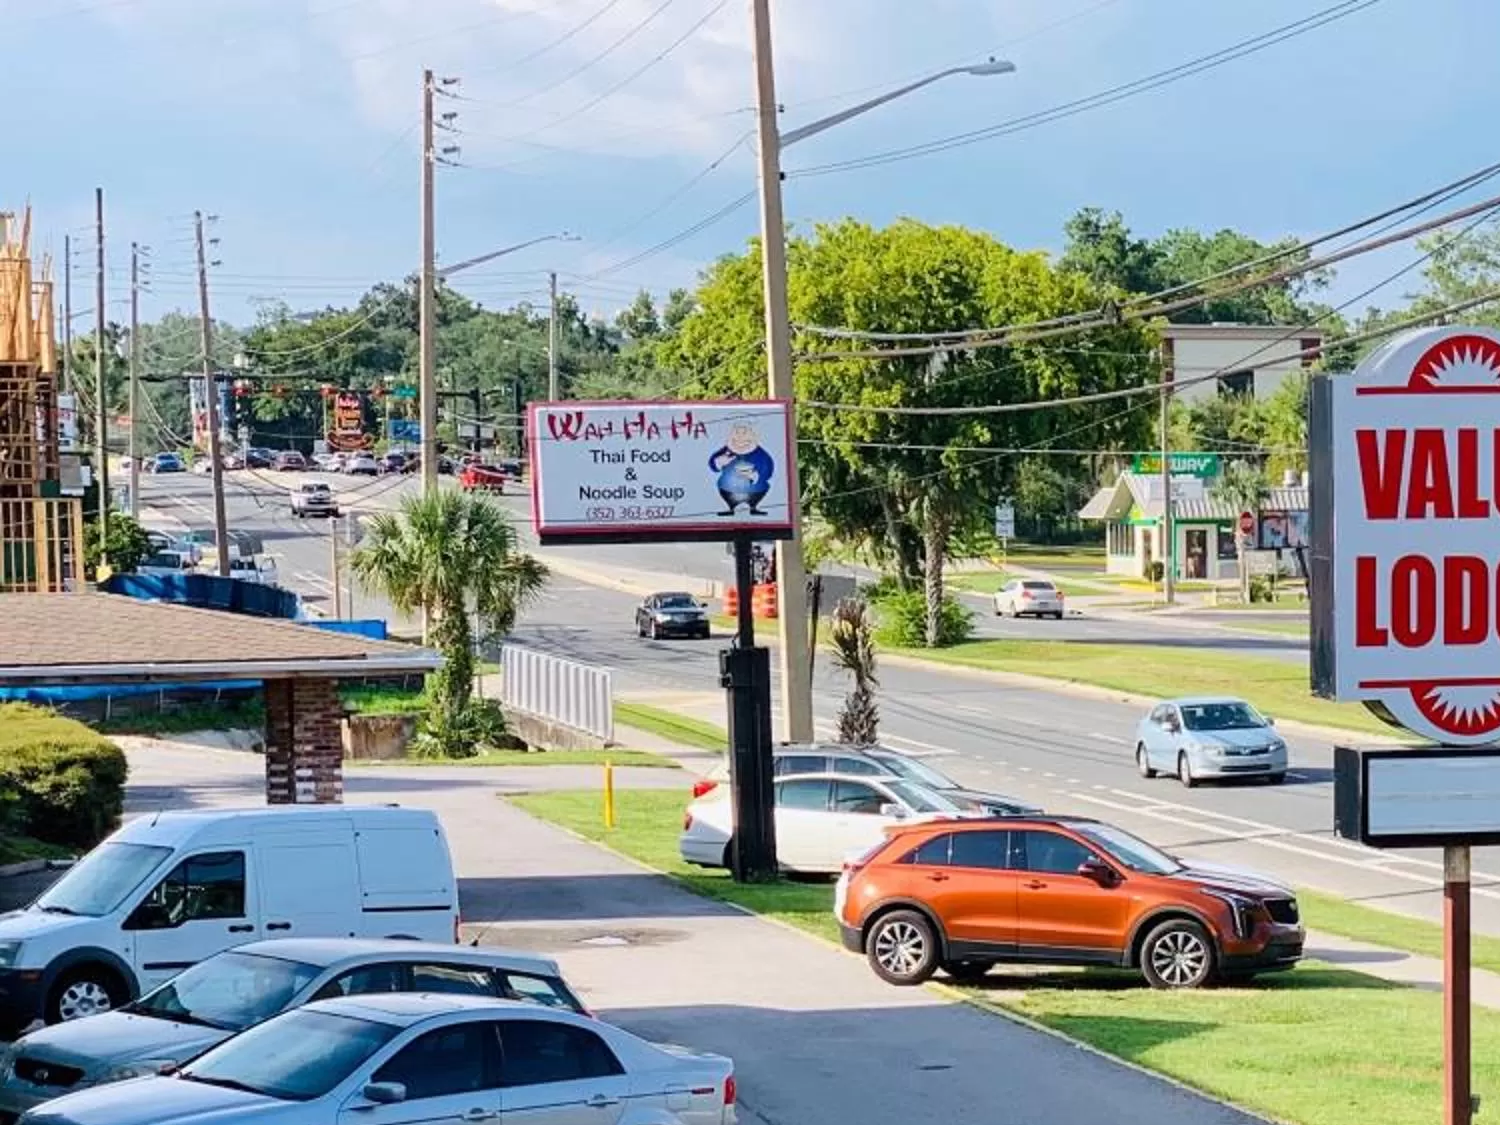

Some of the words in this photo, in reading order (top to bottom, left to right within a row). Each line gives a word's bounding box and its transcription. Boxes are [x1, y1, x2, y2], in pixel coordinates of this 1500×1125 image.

[623, 411, 660, 440] HA
[671, 411, 708, 440] HA
[589, 449, 625, 464] Thai
[631, 449, 671, 464] Food
[624, 467, 638, 481] &
[579, 485, 637, 500] Noodle
[642, 485, 685, 501] Soup
